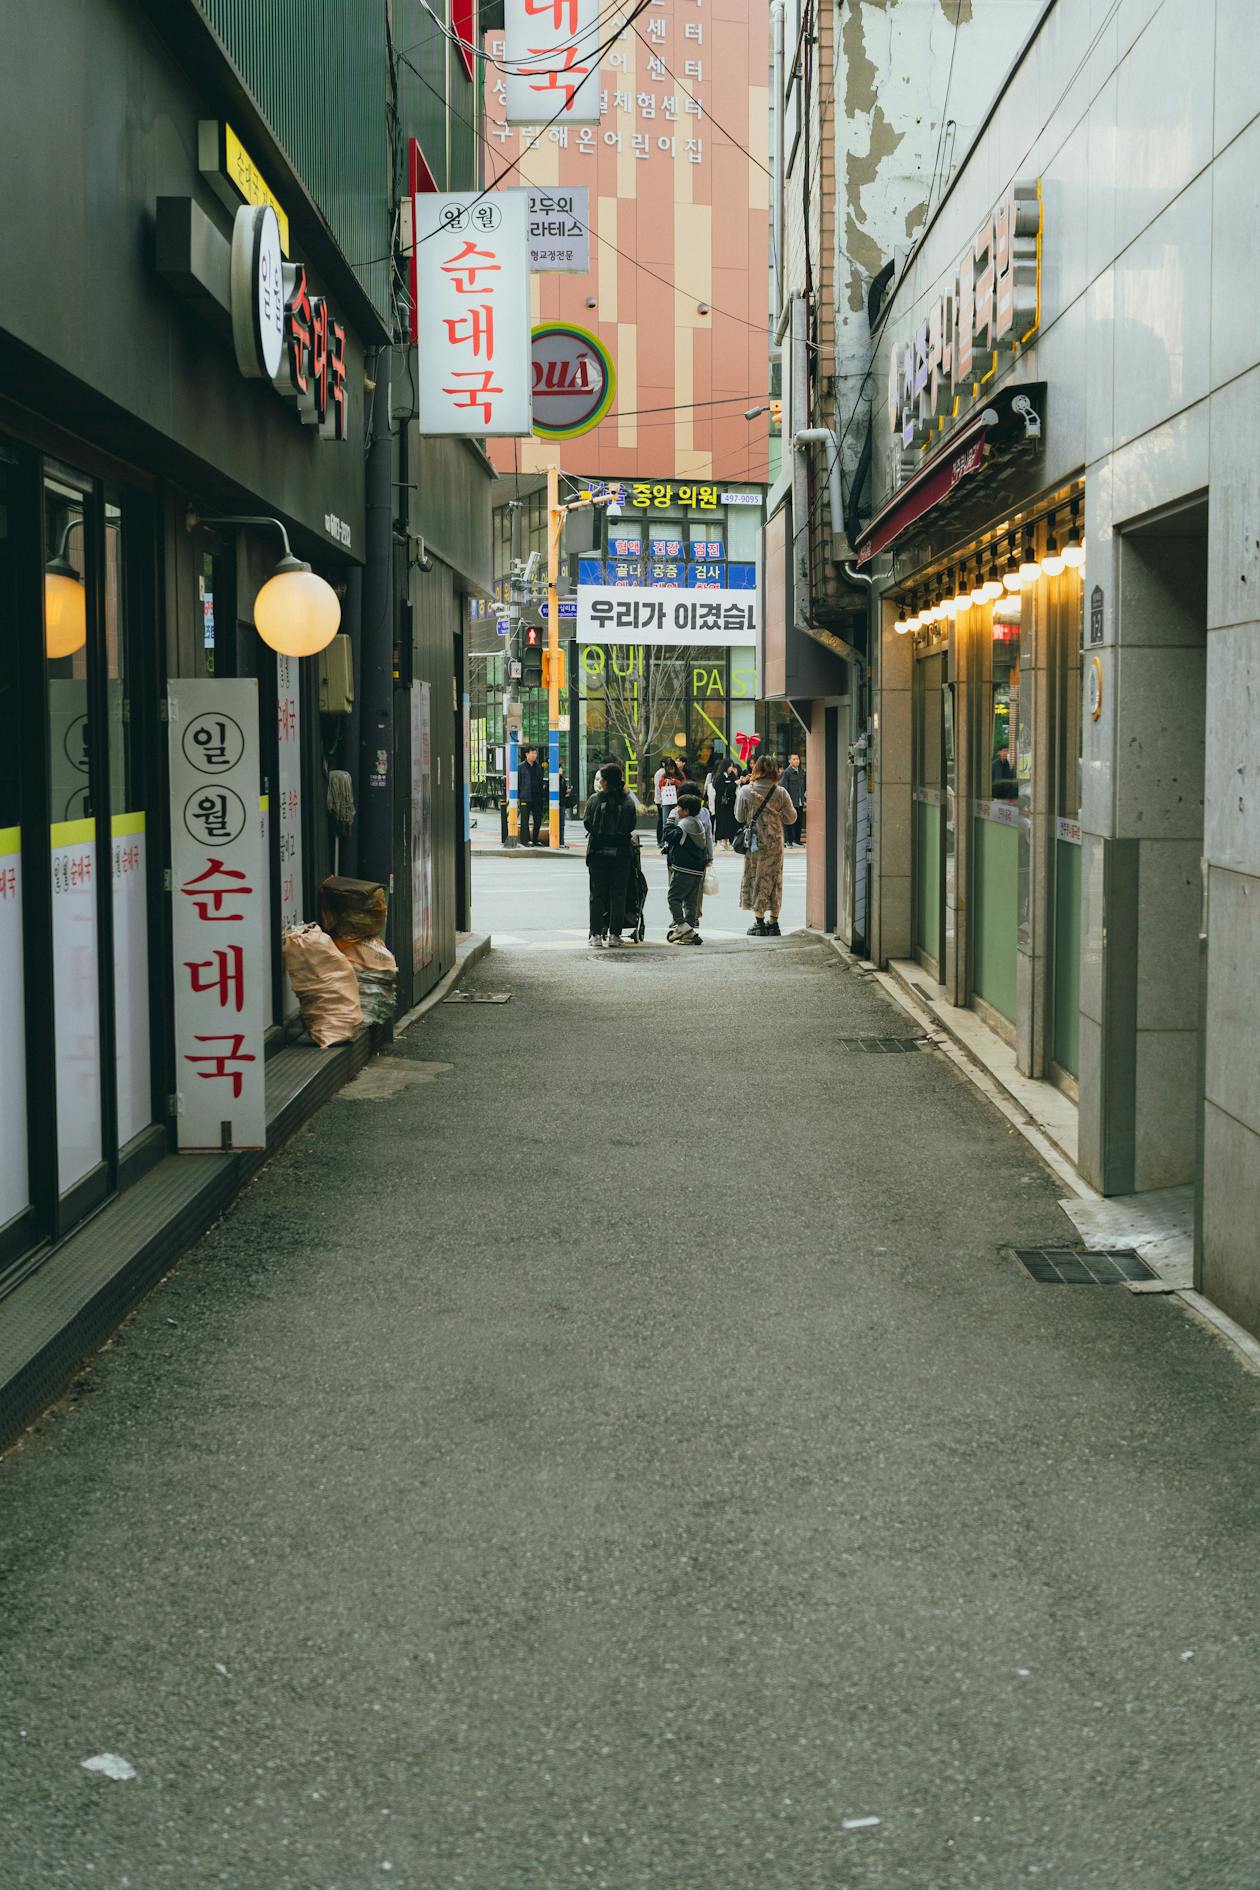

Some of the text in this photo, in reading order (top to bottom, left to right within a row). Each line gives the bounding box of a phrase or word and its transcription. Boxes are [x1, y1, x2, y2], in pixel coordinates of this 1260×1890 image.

[440, 241, 503, 424] 순대국
[632, 483, 674, 508] 중앙
[678, 486, 718, 509] 의원
[590, 600, 667, 629] 우리가
[181, 857, 255, 1098] 순대국
